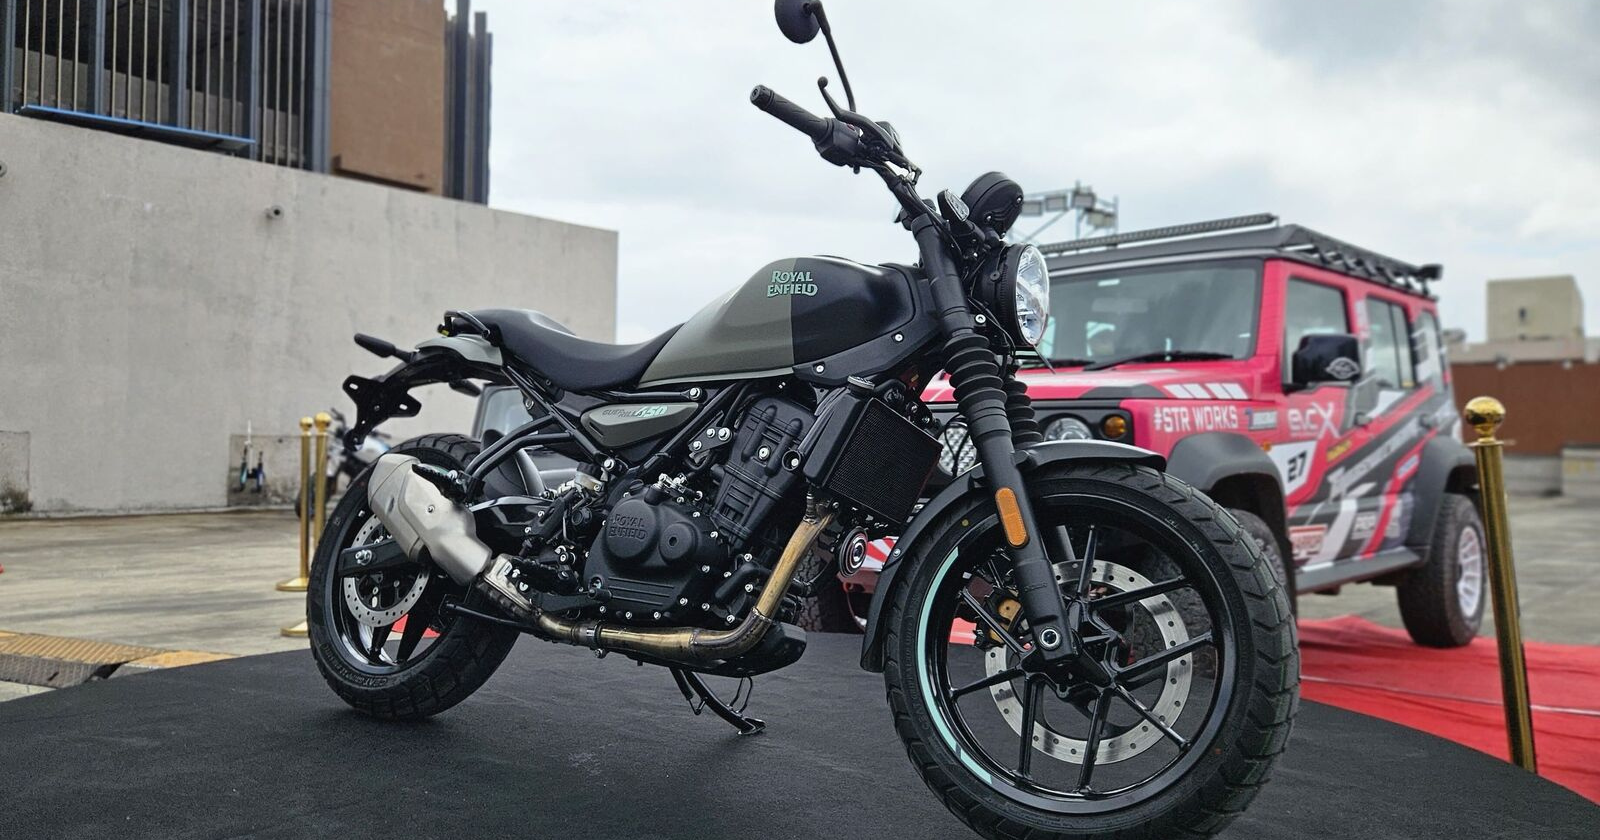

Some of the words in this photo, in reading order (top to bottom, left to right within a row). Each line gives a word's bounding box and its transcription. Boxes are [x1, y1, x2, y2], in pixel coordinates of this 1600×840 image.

[771, 270, 814, 284] ROYAL
[767, 283, 819, 298] ENFIELD
[1154, 405, 1191, 432] #STR
[1192, 404, 1239, 430] WORKS
[1287, 450, 1308, 483] 27
[612, 513, 645, 527] ROYAL
[609, 526, 649, 540] ENFIELD
